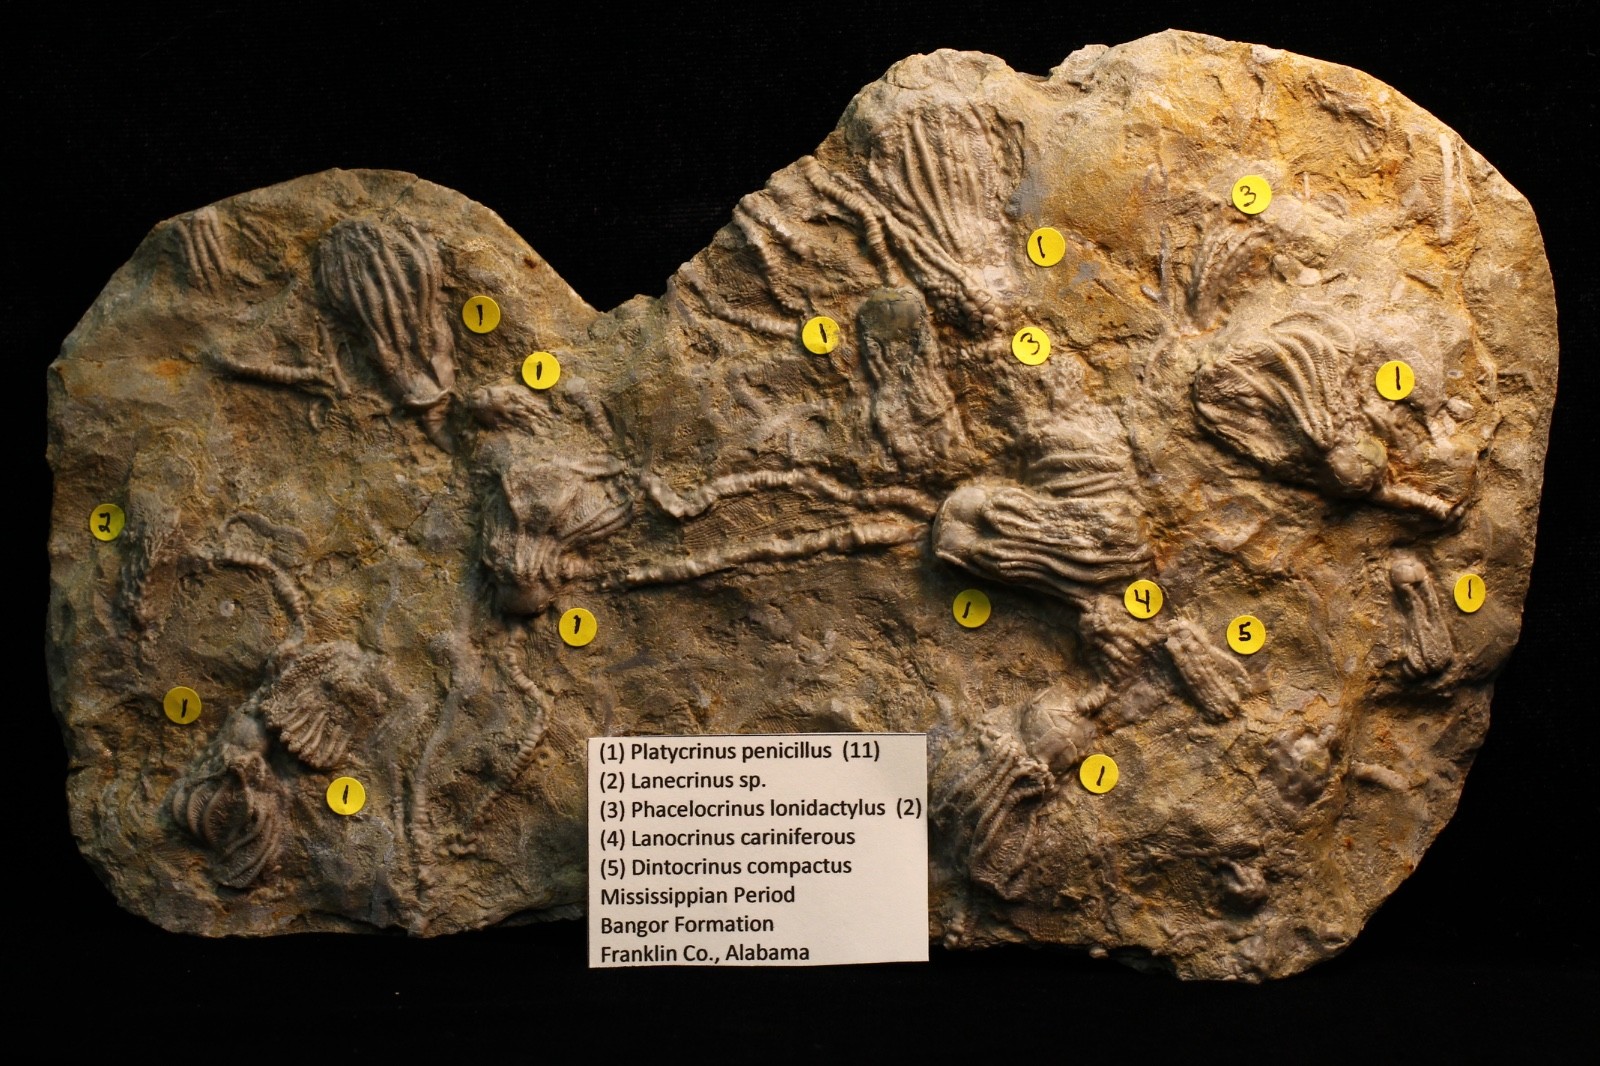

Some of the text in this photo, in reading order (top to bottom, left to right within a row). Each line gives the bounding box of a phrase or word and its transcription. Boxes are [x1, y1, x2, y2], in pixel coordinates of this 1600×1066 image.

[1240, 186, 1256, 207] 3
[1020, 333, 1040, 355] 3
[99, 512, 112, 533] 2
[1133, 588, 1151, 613] 4
[1238, 622, 1251, 642] 5
[600, 741, 879, 764] (1) Platycrinus penicillus (11)
[600, 772, 765, 793] (2) Lanecrinus sp.
[601, 798, 921, 822] (3) Phacelocrinus lonidactylus (2)
[601, 828, 855, 851] (4) Lanocrinus cariniferous
[601, 858, 851, 880] (5) Dintocrinus compactus
[601, 886, 794, 908] Mississippian Period
[602, 915, 774, 937] Bangor Formation
[602, 944, 809, 964] Franklin Co., Alabama
